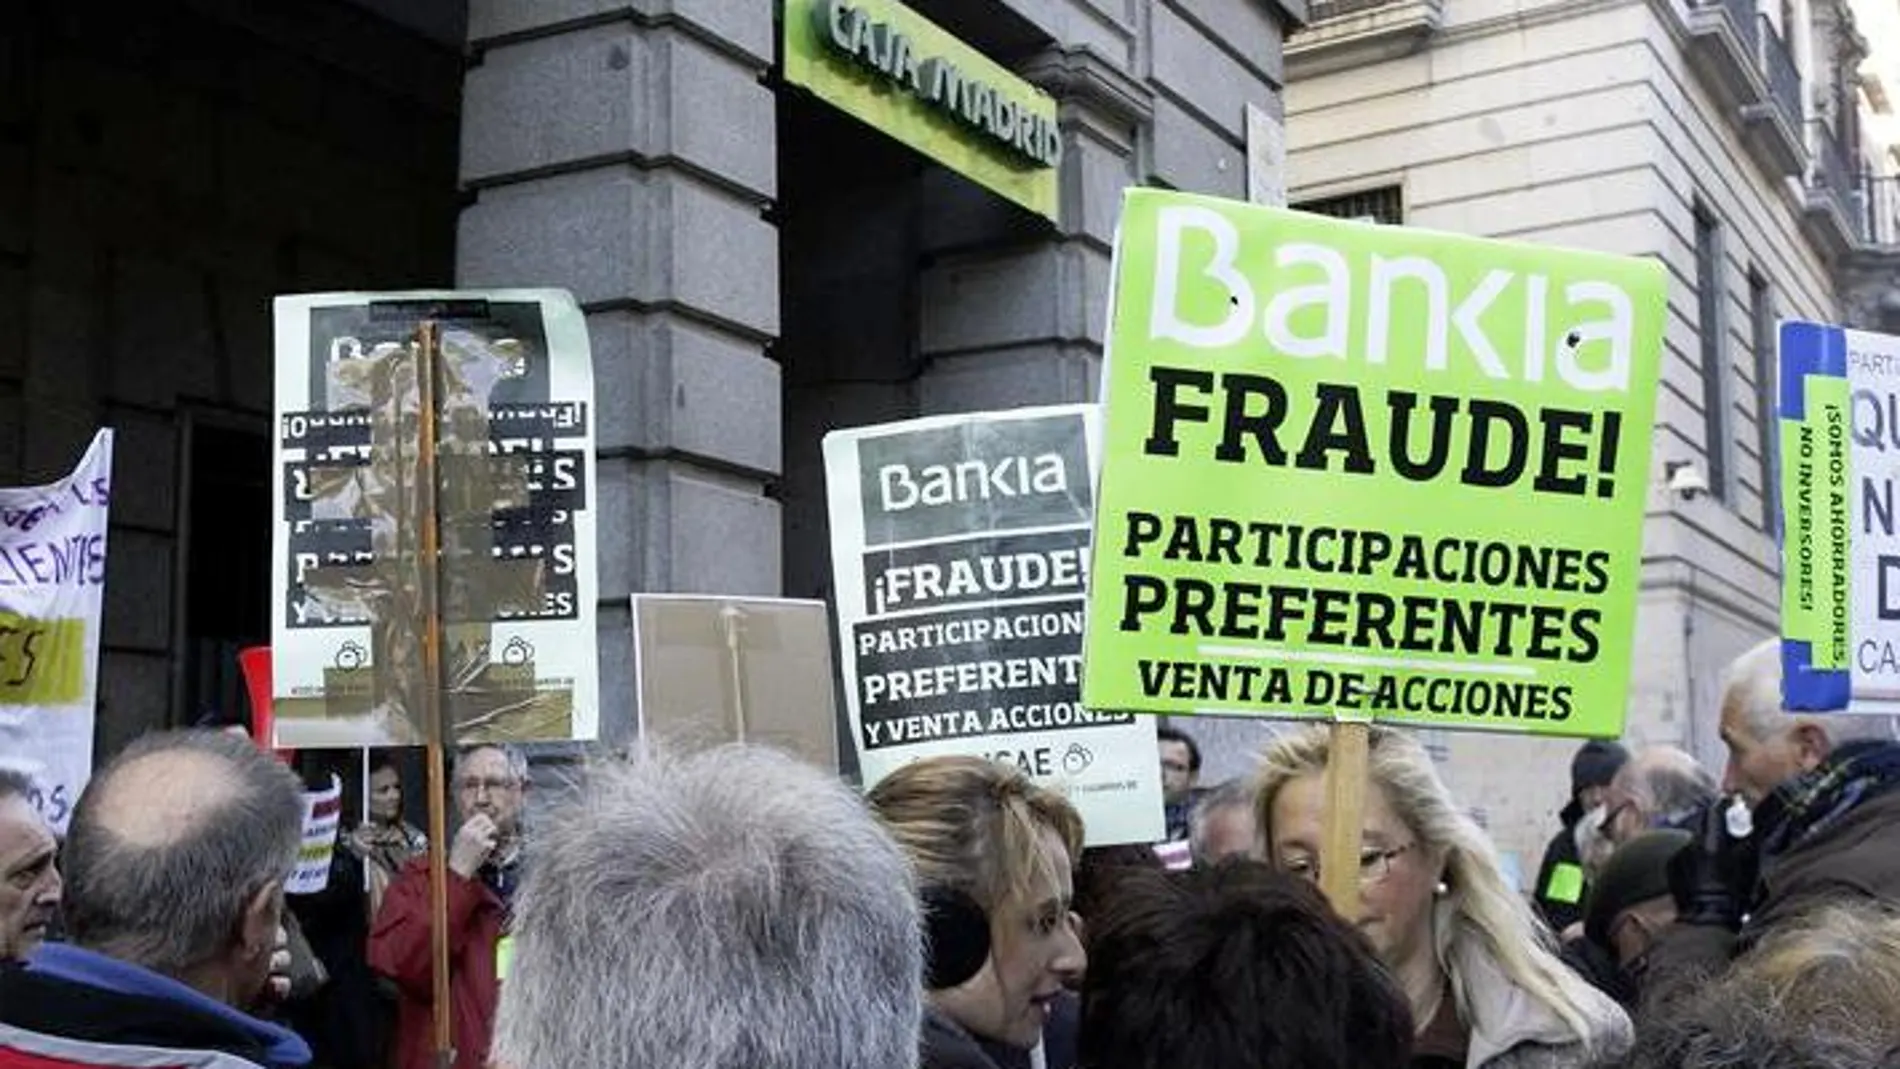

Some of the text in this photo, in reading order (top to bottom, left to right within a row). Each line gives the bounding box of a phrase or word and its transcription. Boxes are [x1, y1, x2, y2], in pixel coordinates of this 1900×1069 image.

[826, 0, 1062, 167] CAJA MADRID
[1148, 205, 1634, 391] Bankia
[1849, 350, 1900, 376] PART
[1144, 366, 1622, 498] FRAUDE!
[880, 452, 1067, 511] Bankia
[1798, 426, 1814, 611] NO INVERSORES!
[1123, 512, 1610, 594] PARTICIPACIONES
[1120, 575, 1602, 664] PREFERENTES
[1857, 640, 1900, 675] CA
[865, 722, 881, 745] Y
[887, 710, 982, 742] VENTA
[1138, 659, 1572, 721] VENTA DE ACCIONES
